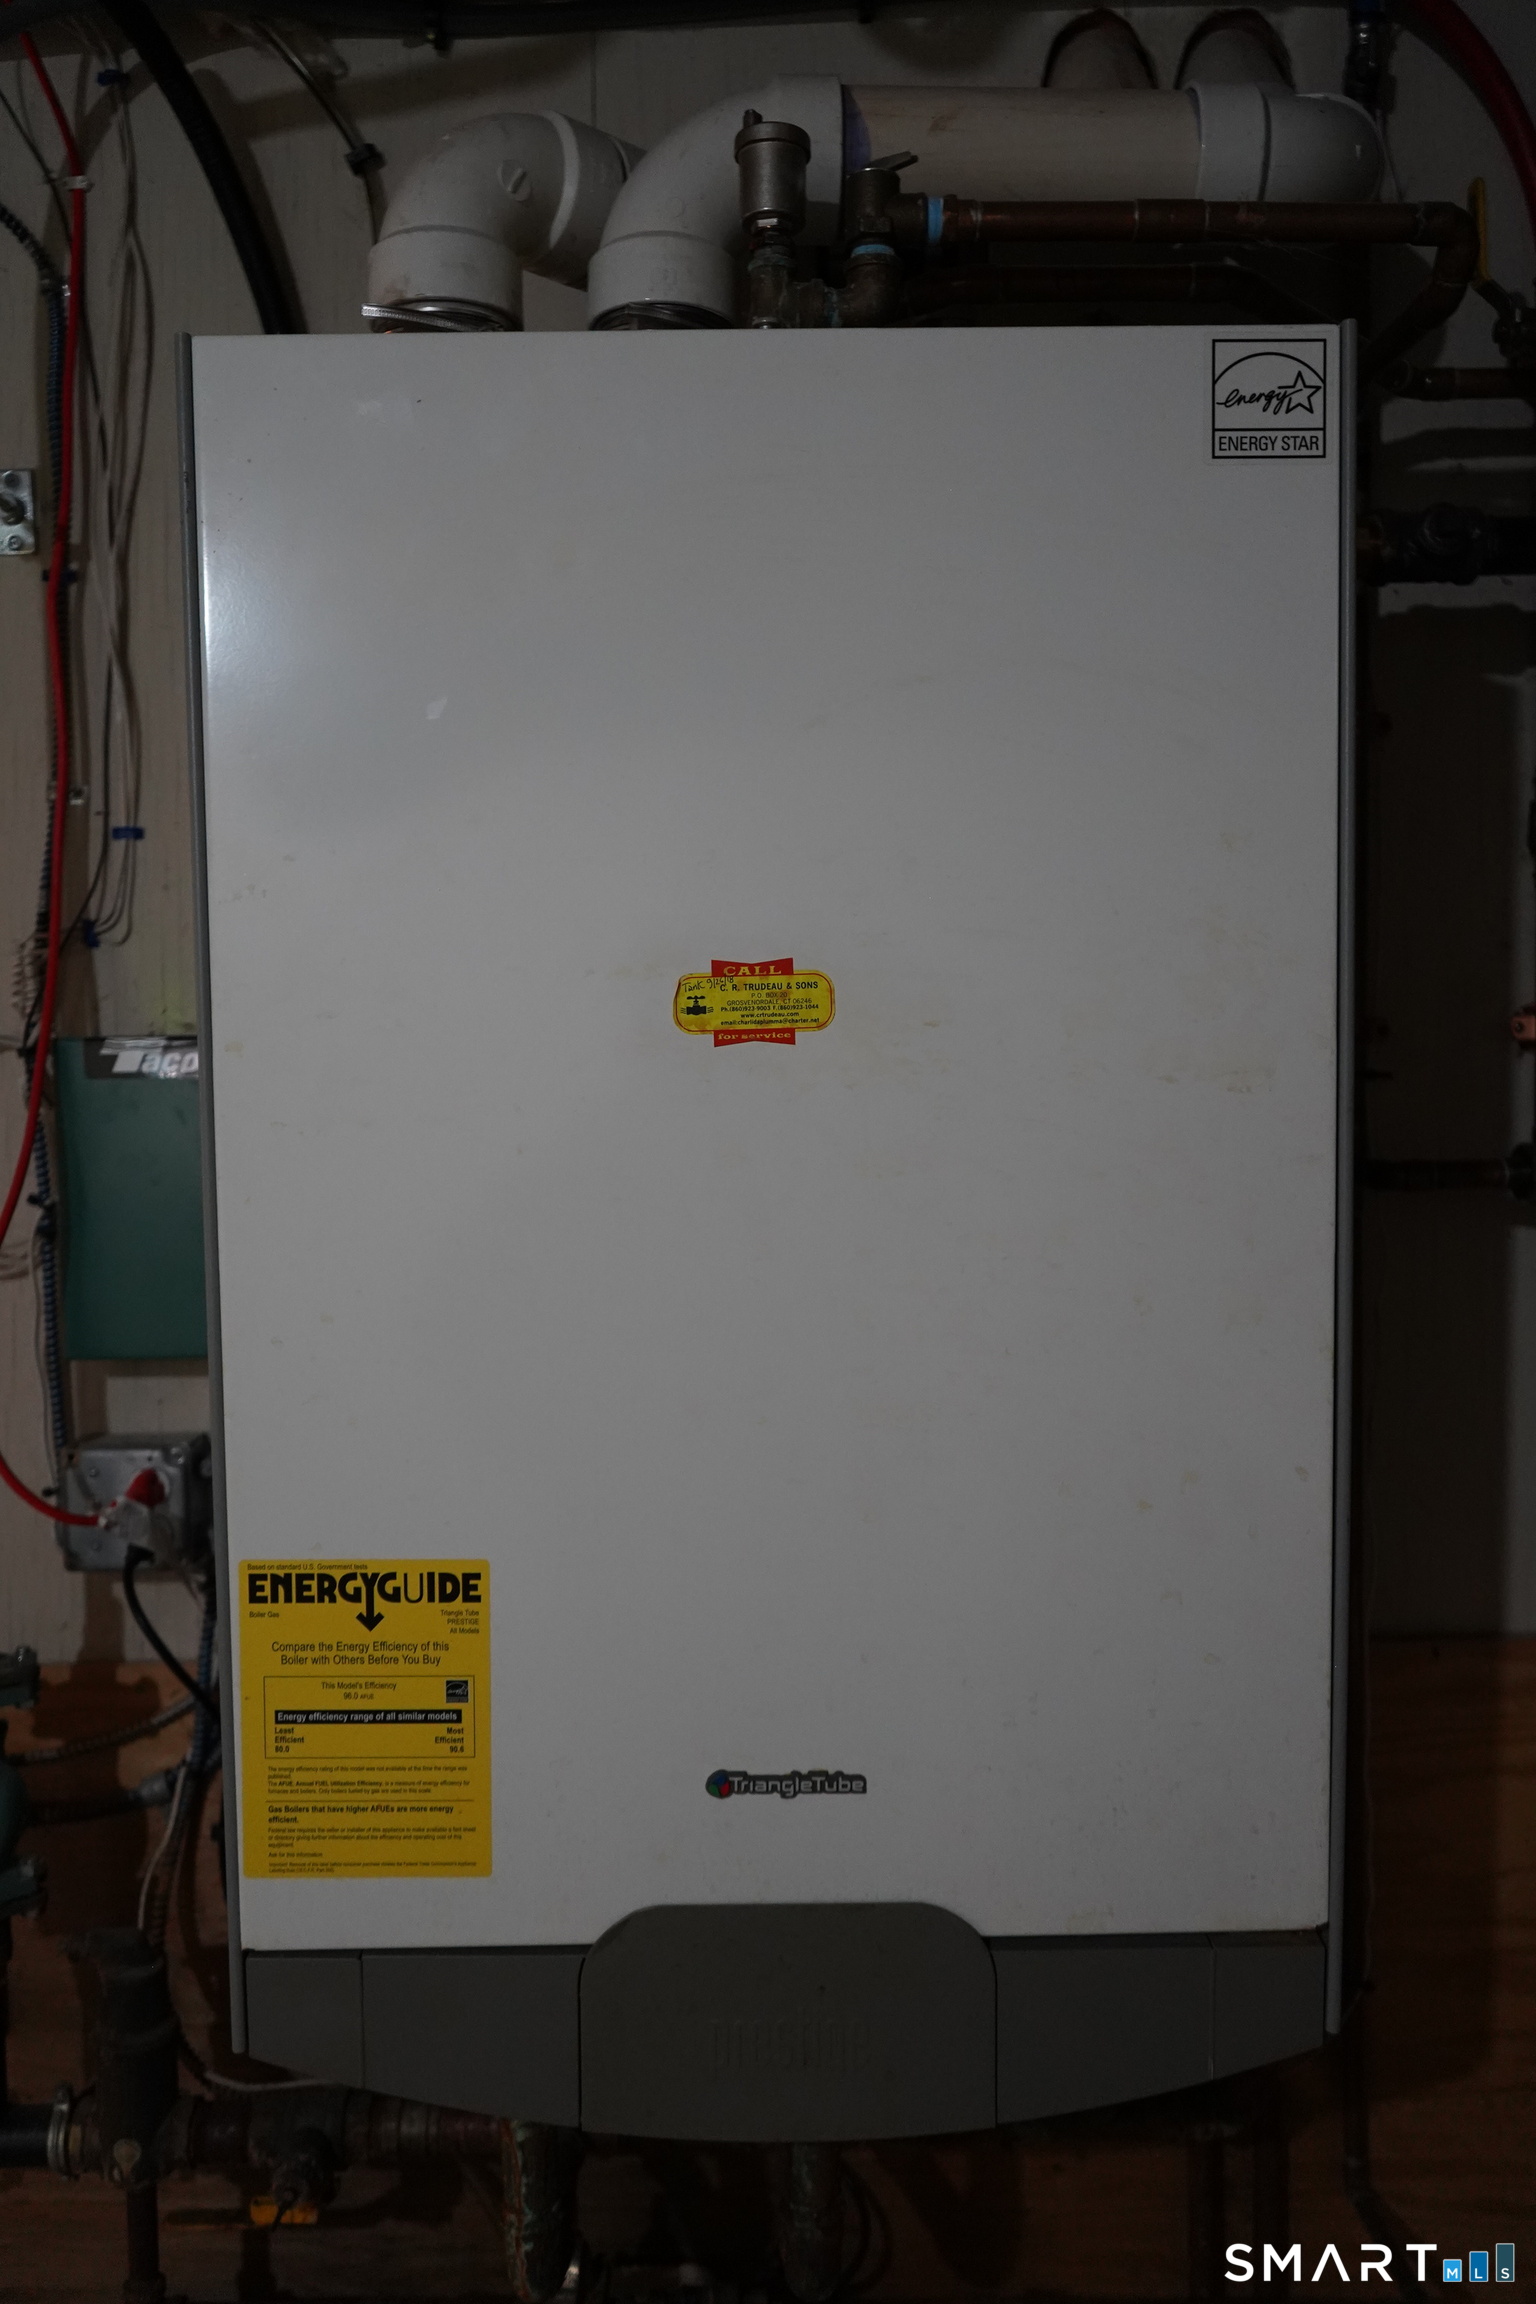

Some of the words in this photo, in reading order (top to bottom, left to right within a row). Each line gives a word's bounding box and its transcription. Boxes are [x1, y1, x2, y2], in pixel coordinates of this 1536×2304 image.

[1216, 389, 1302, 415] energy
[1219, 436, 1277, 451] ENERGY
[1281, 436, 1319, 451] STAR
[723, 965, 782, 975] CALL
[248, 1572, 481, 1604] ENERGYGUIDE
[441, 1609, 463, 1617] Triangle
[272, 1642, 315, 1654] Compare
[318, 1642, 333, 1651] the
[336, 1642, 369, 1654] Energy
[373, 1641, 417, 1653] Efficiency
[421, 1641, 430, 1651] of
[433, 1641, 449, 1651] this
[281, 1655, 308, 1665] Boiler
[311, 1655, 330, 1665] with
[333, 1655, 365, 1665] Others
[368, 1655, 399, 1665] Before
[402, 1655, 419, 1664] You
[423, 1655, 441, 1666] Buy
[364, 1682, 396, 1691] Efficiency
[277, 1713, 307, 1723] Energy
[309, 1712, 348, 1723] efficiency
[350, 1714, 373, 1723] range
[376, 1712, 384, 1721] of
[386, 1712, 395, 1721] all
[398, 1712, 425, 1721] similar
[428, 1712, 457, 1721] models
[729, 1777, 864, 1796] TriangleTube
[346, 1805, 368, 1815] higher
[370, 1805, 394, 1813] AFUEs
[429, 1807, 453, 1815] energy
[268, 1816, 299, 1824] efficient.
